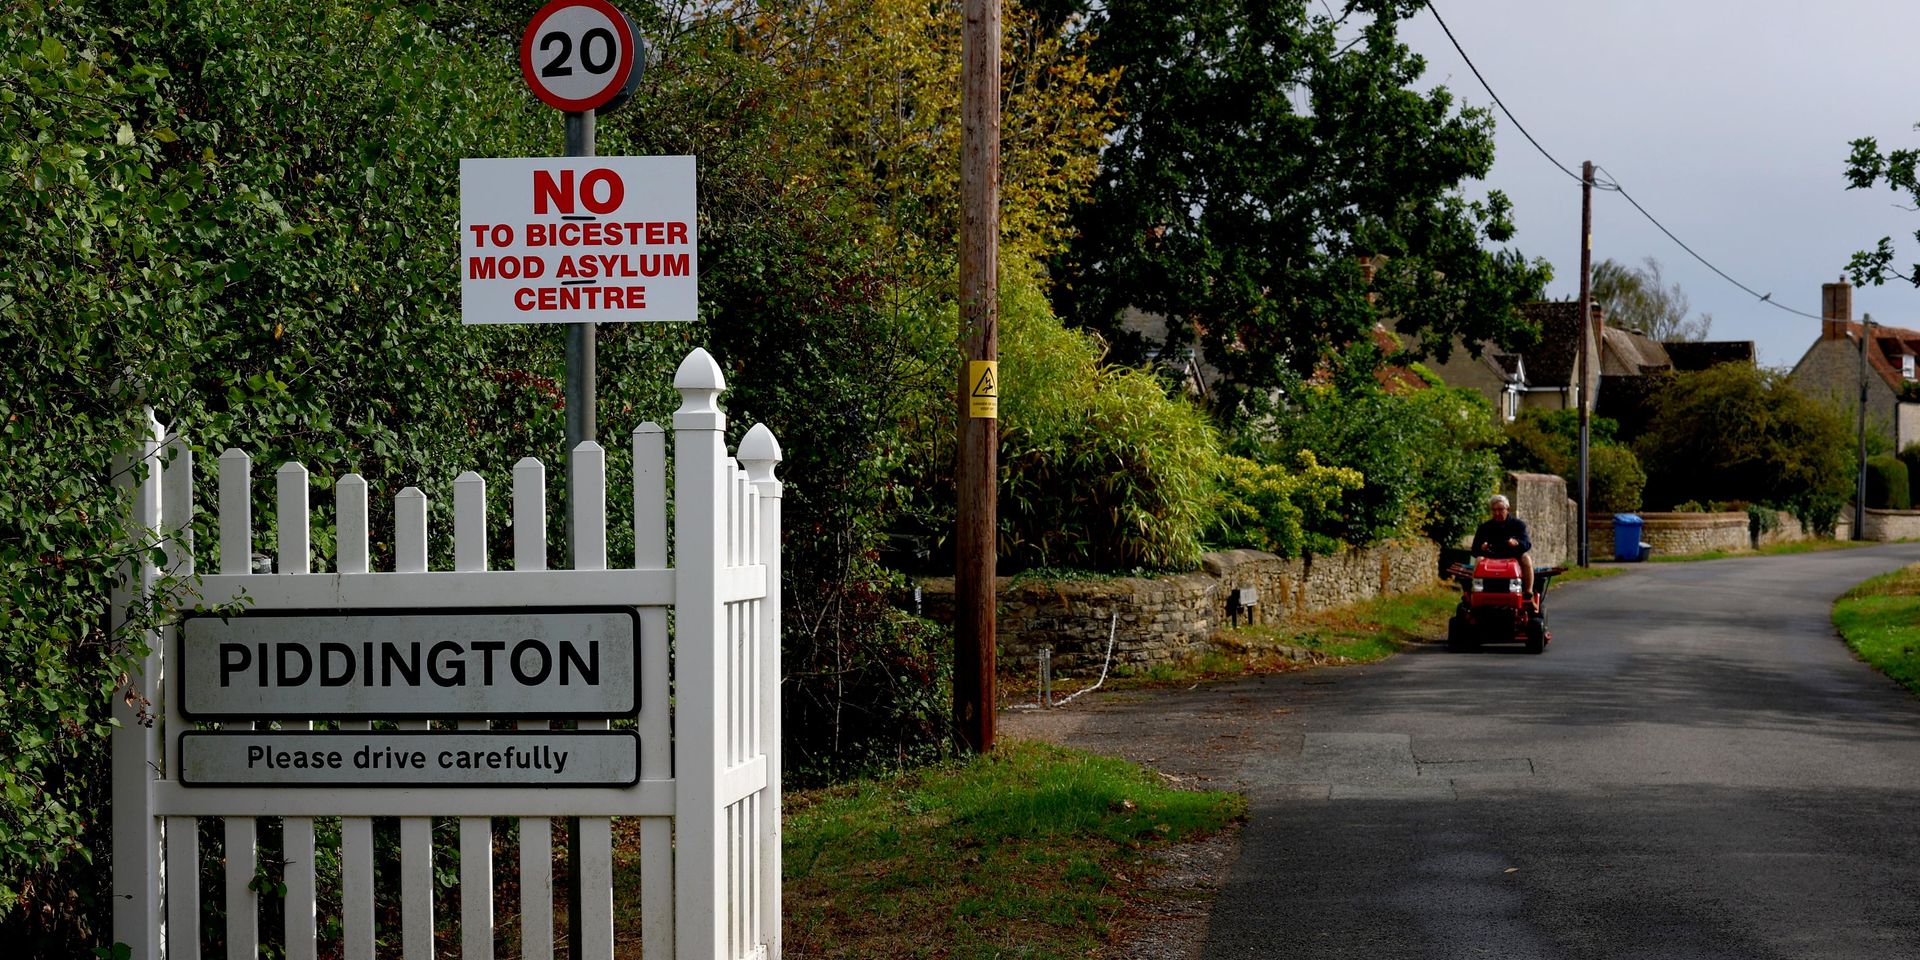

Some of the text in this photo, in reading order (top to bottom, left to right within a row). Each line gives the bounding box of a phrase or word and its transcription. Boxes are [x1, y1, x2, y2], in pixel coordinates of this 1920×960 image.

[540, 27, 617, 78] 20
[533, 168, 625, 215] NO
[470, 222, 688, 247] TO BICESTER
[469, 253, 690, 279] MOD ASYLUM
[514, 286, 646, 311] CENTRE
[219, 639, 600, 688] PIDDINGTON
[247, 745, 569, 774] Please drive carefully
